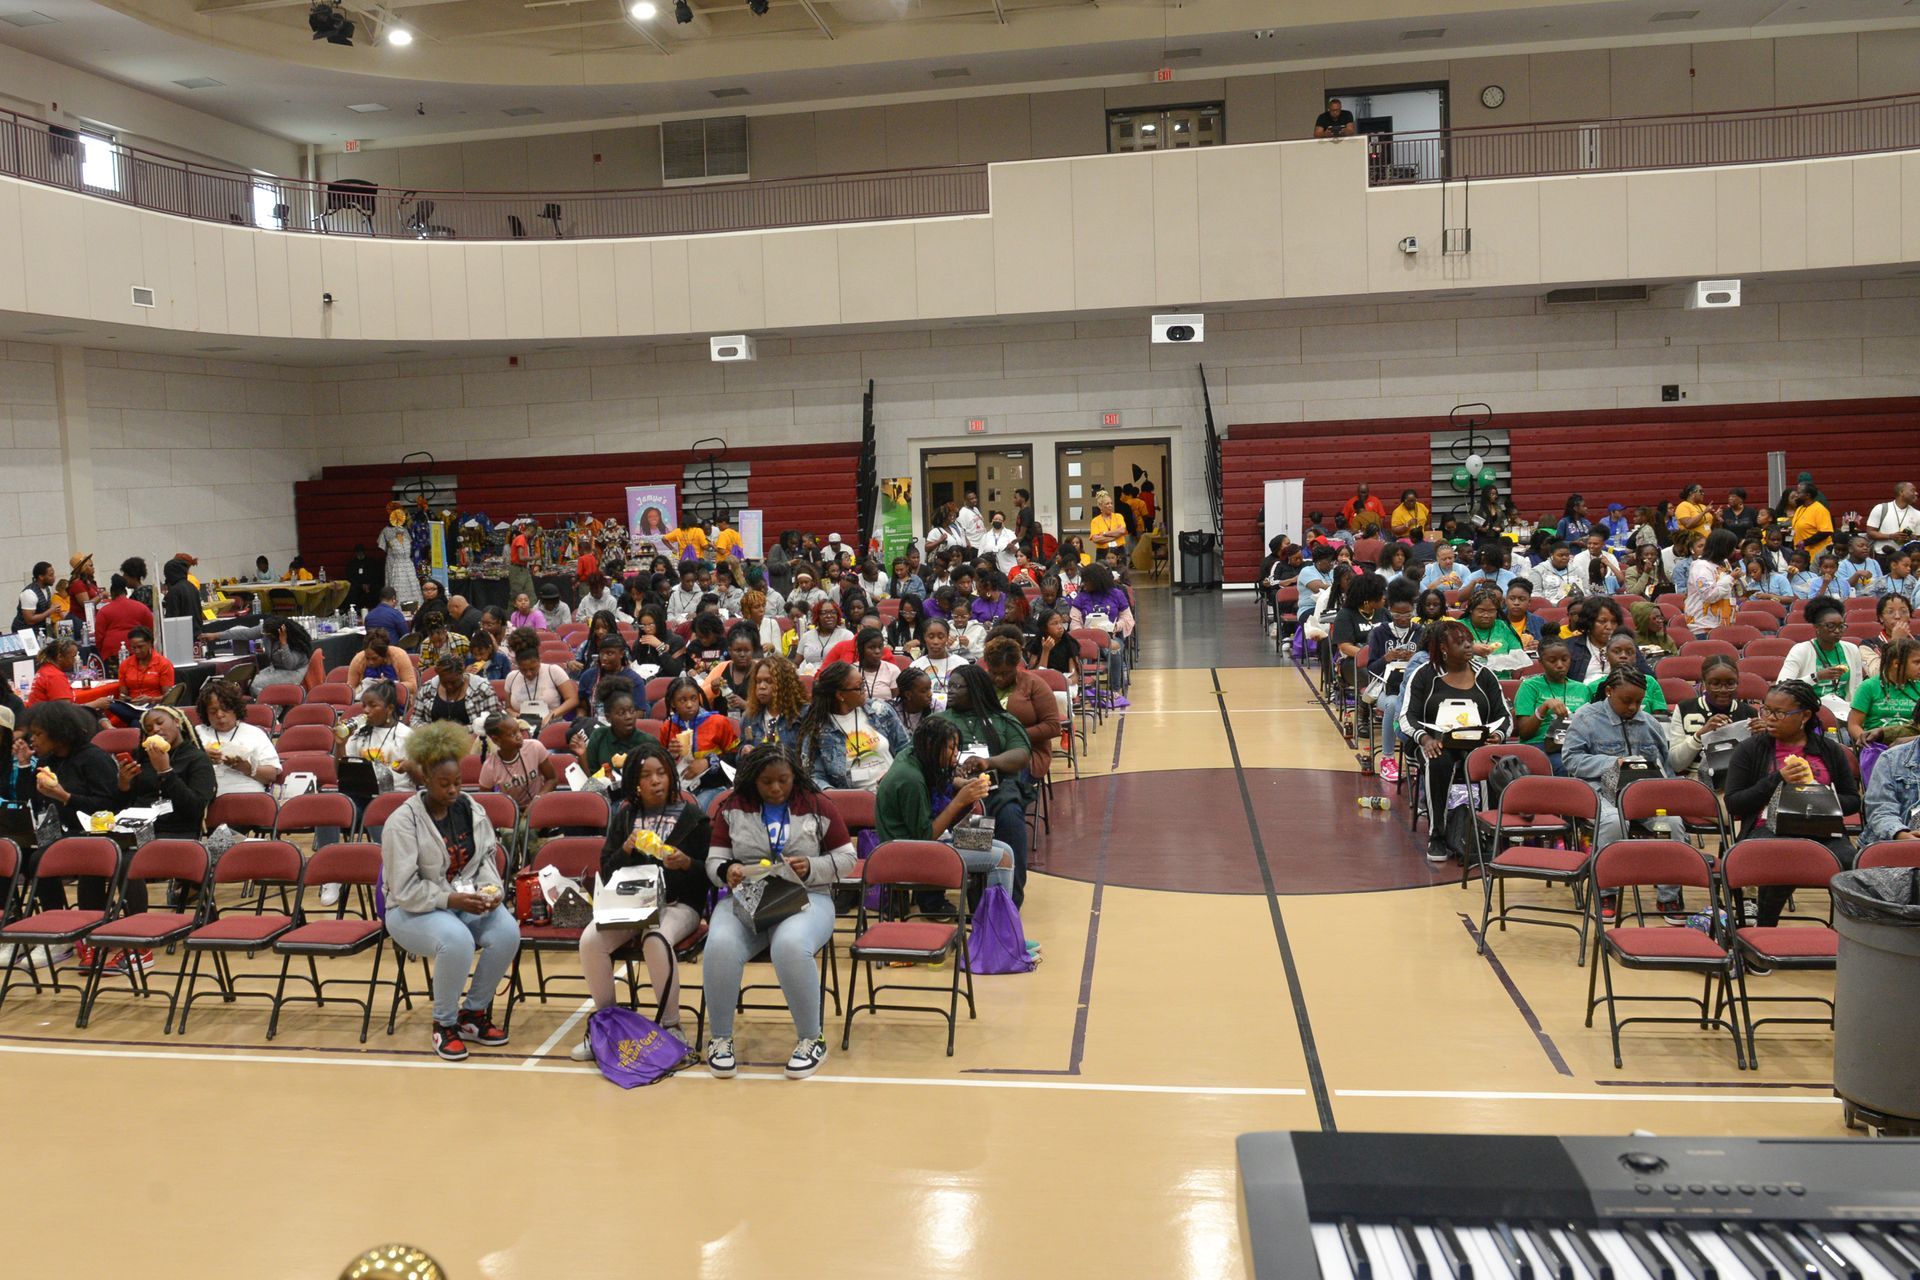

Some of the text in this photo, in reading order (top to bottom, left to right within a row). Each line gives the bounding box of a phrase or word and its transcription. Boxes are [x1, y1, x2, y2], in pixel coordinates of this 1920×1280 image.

[1157, 68, 1173, 81] EXIT
[968, 419, 985, 431] EXIT
[1103, 413, 1120, 425] EXIT
